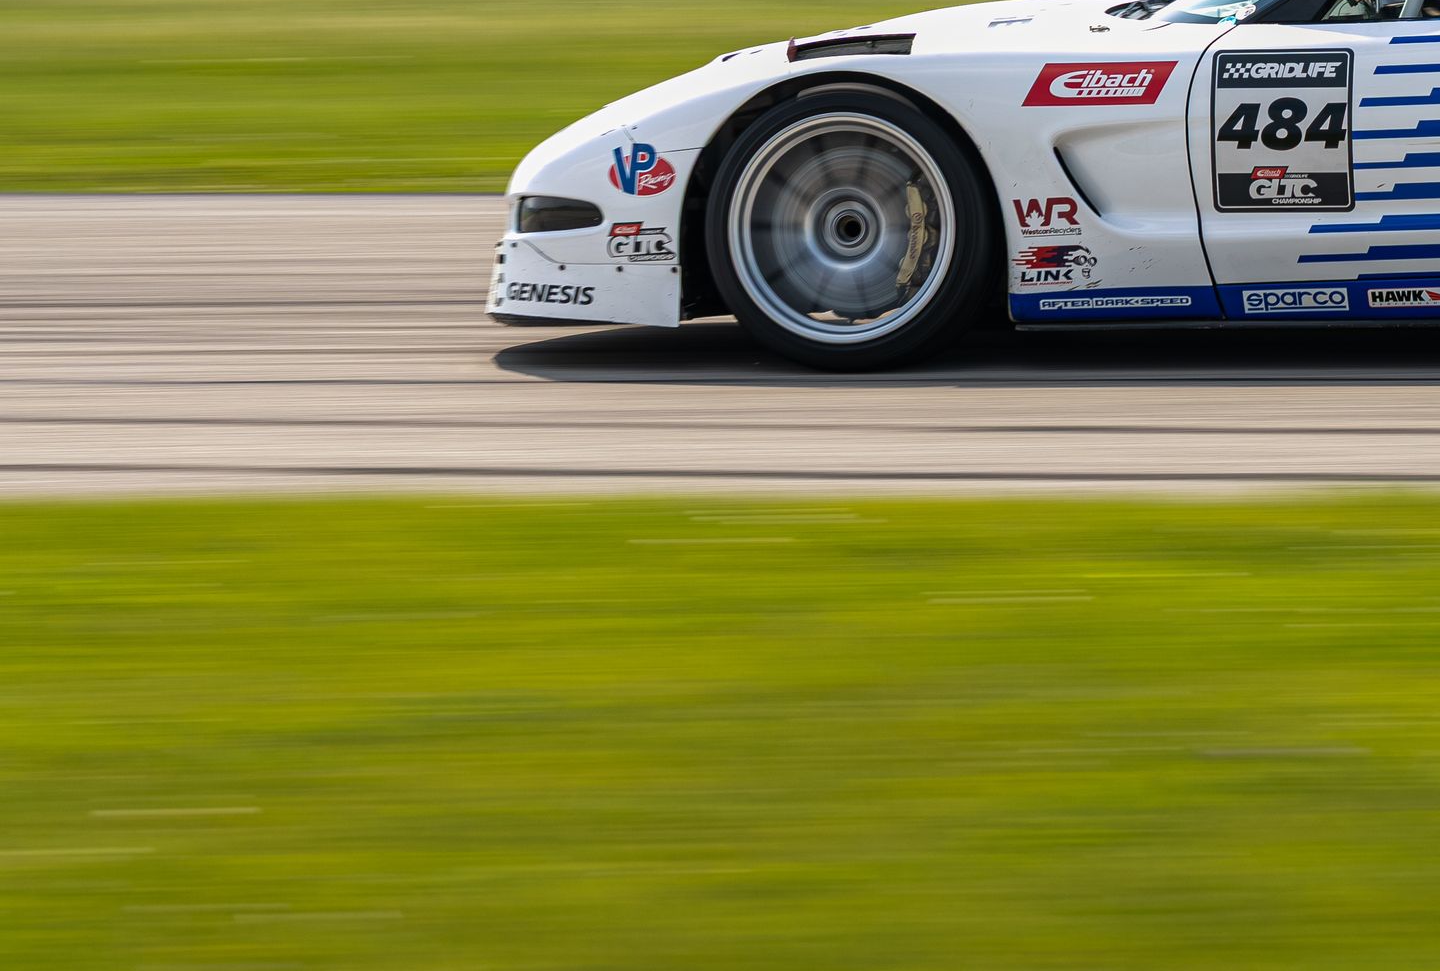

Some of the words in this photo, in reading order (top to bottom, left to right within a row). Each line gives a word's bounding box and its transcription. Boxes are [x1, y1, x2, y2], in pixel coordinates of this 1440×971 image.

[1249, 61, 1343, 79] GRIDLIFE
[1049, 68, 1153, 98] Eibach
[1216, 96, 1348, 151] 484
[613, 141, 657, 196] VP
[638, 172, 676, 190] Racing
[1248, 178, 1318, 199] GLTC
[1012, 197, 1081, 228] WR
[1020, 268, 1075, 283] LINK
[506, 281, 596, 306] GENESIS
[1041, 299, 1091, 309] AFTER
[1139, 296, 1190, 306] SPEED
[1246, 290, 1346, 311] sparco
[1371, 289, 1426, 303] HAWK
